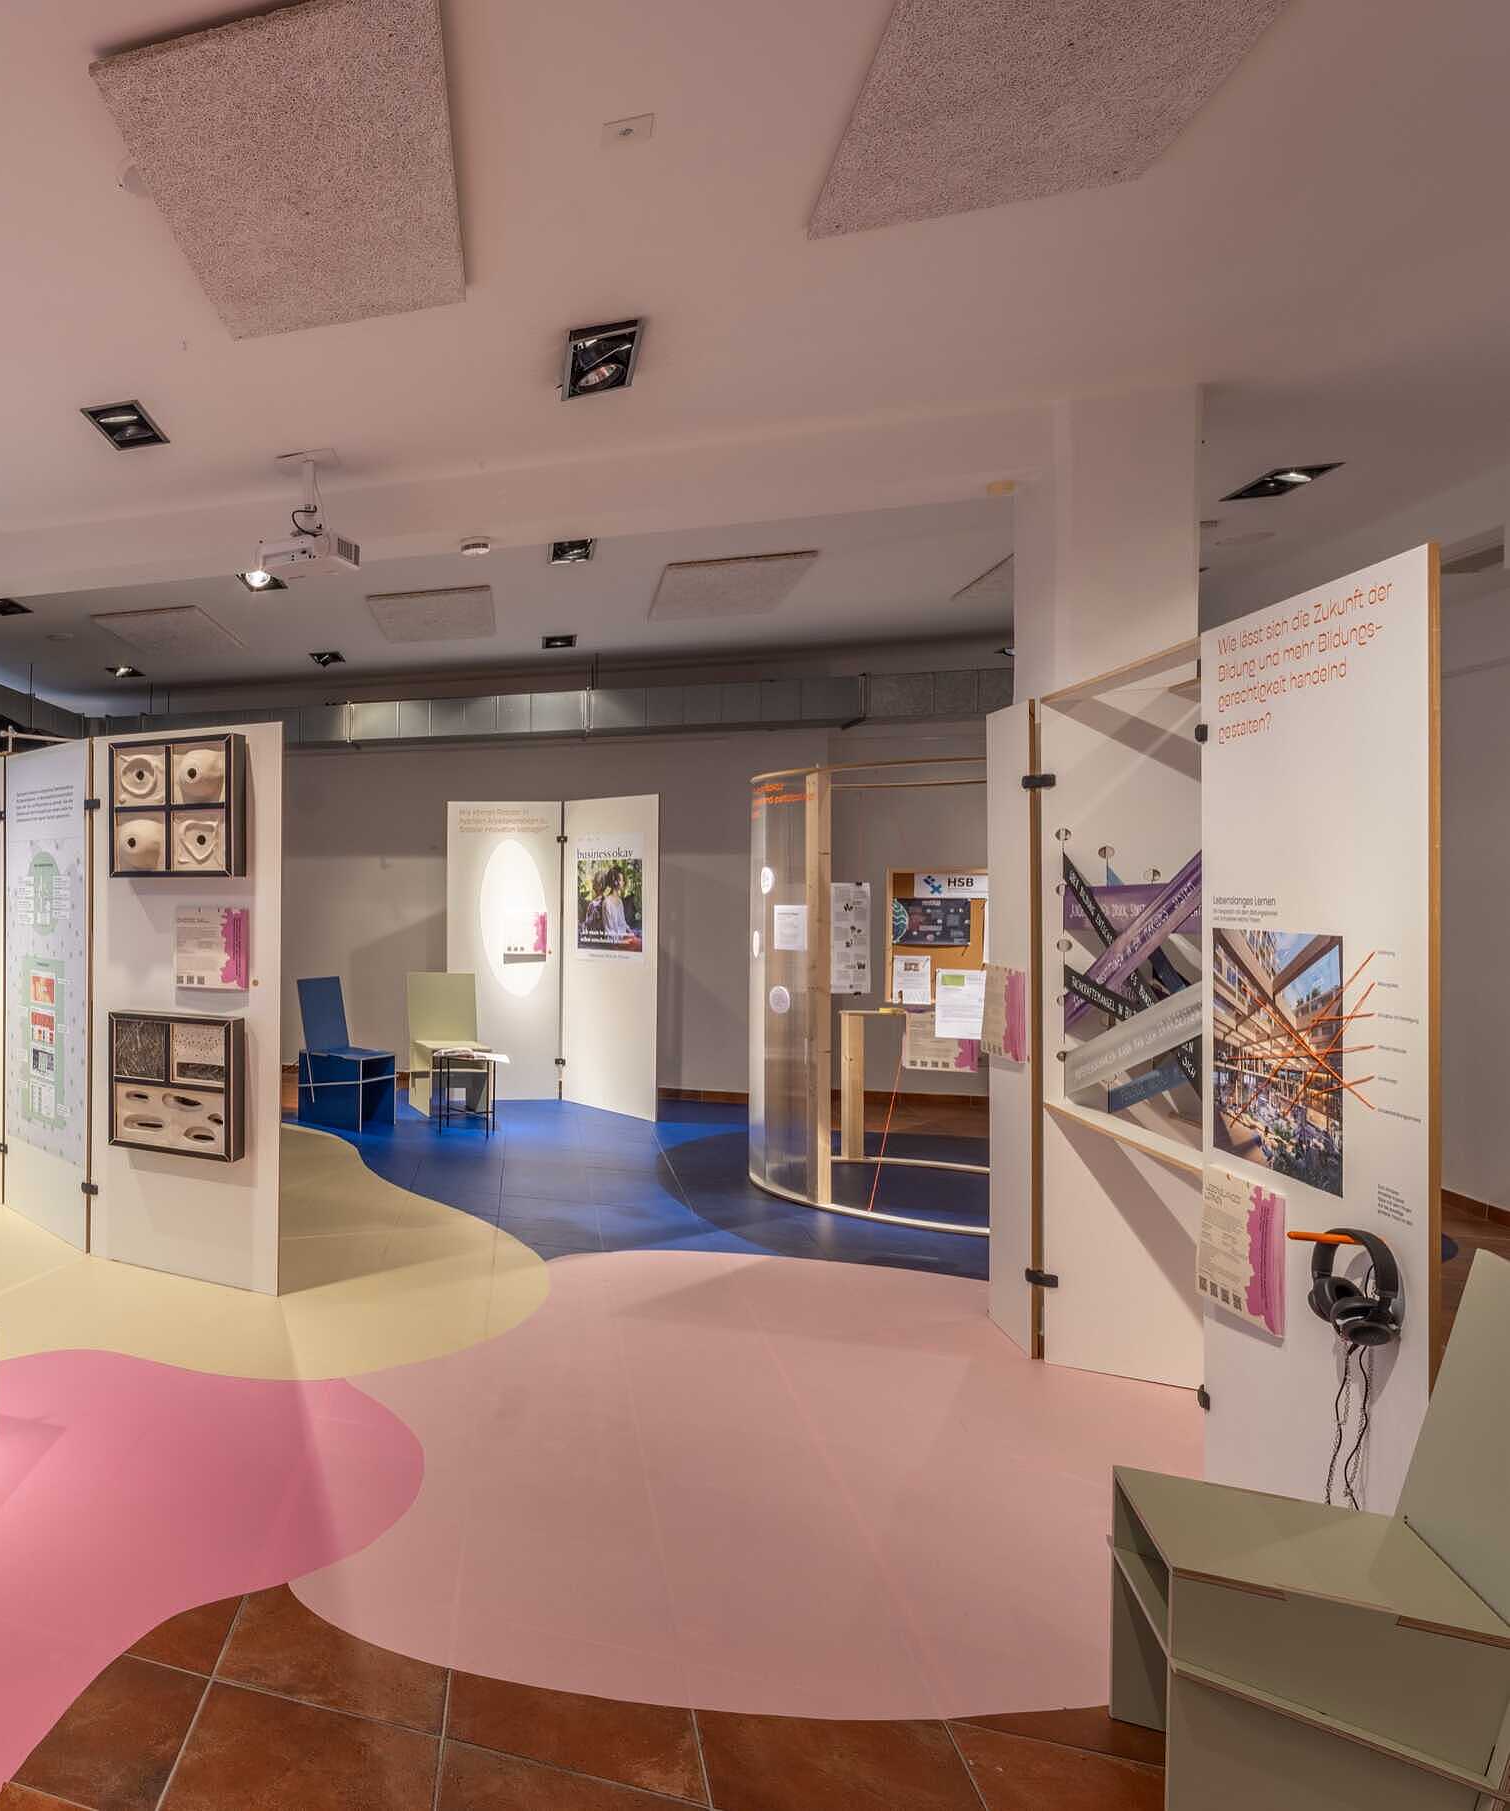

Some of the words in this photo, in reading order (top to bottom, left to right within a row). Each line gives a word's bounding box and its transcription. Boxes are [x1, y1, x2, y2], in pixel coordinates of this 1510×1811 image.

[1218, 636, 1238, 656] Wie
[1266, 616, 1290, 639] sich
[1292, 608, 1310, 631] die
[1313, 589, 1365, 624] Zukunft
[1368, 582, 1394, 606] der
[1218, 659, 1256, 683] Bildung
[1259, 648, 1280, 671] und
[1282, 637, 1314, 662] mehr
[1318, 621, 1384, 654] Bildungs-
[1218, 676, 1286, 713] gerechtigkeit
[1290, 656, 1348, 690] handelnd
[1218, 711, 1274, 745] gestalten?
[947, 877, 974, 888] HSB
